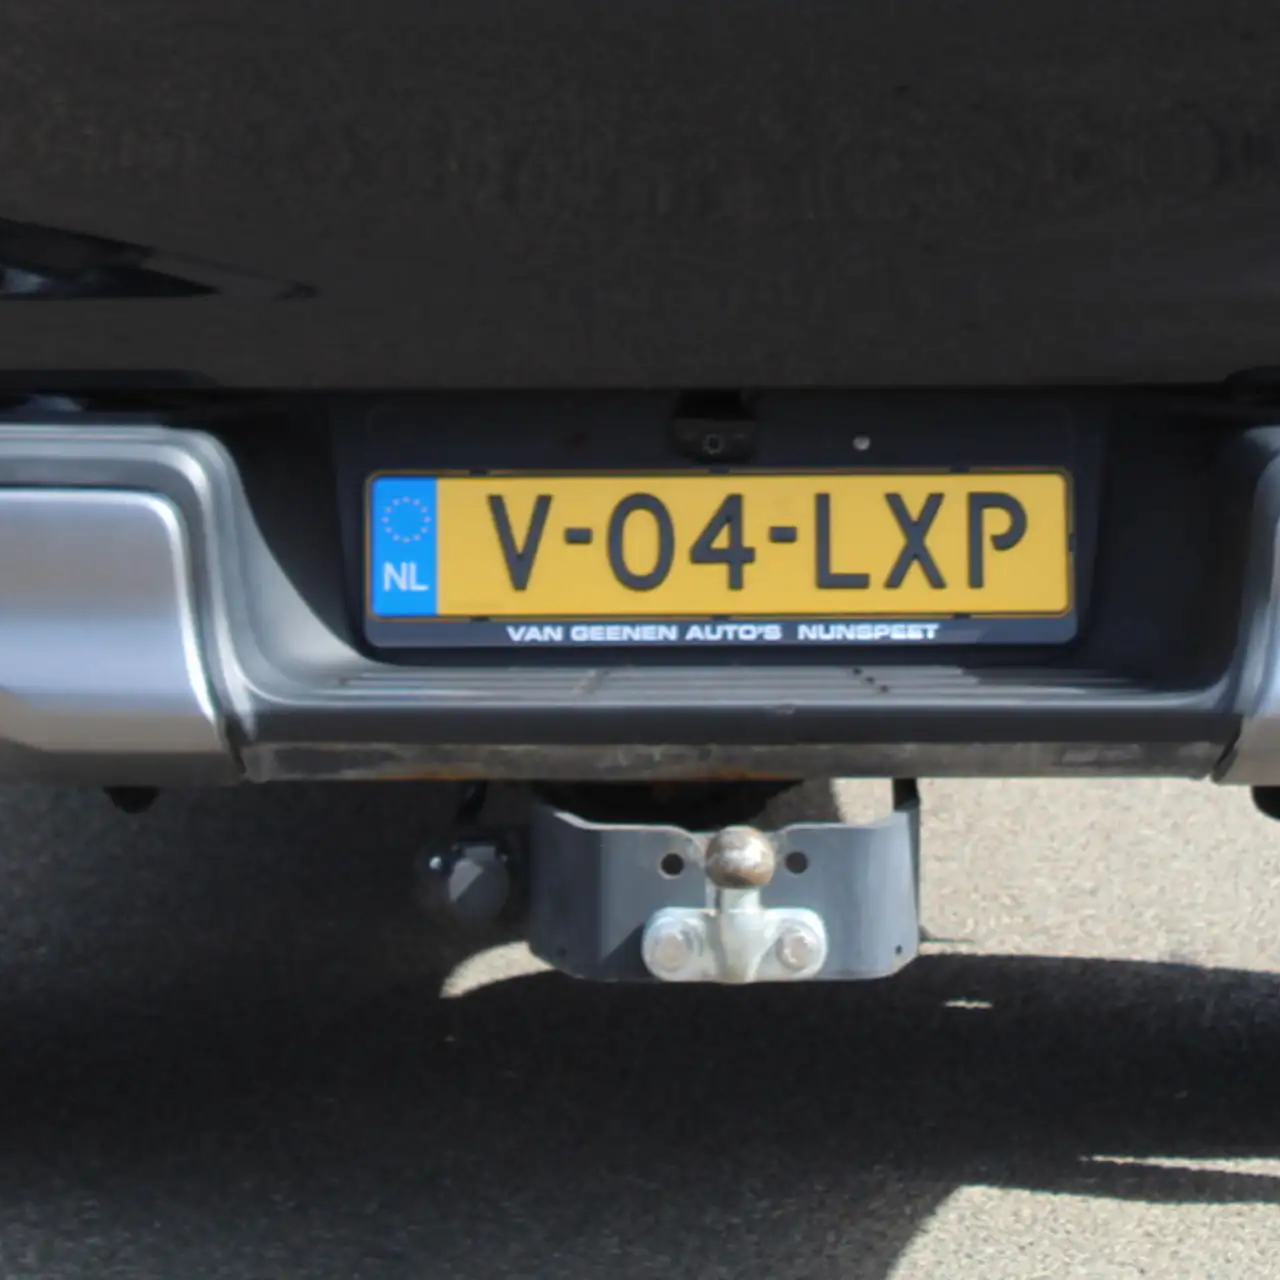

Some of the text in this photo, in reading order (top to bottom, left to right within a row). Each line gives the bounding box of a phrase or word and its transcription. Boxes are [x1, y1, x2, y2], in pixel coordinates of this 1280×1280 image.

[486, 492, 1029, 592] V-04-LXP
[383, 561, 429, 592] NL
[506, 623, 940, 642] VAN GEENEN AUTO'S NUNSPEET
